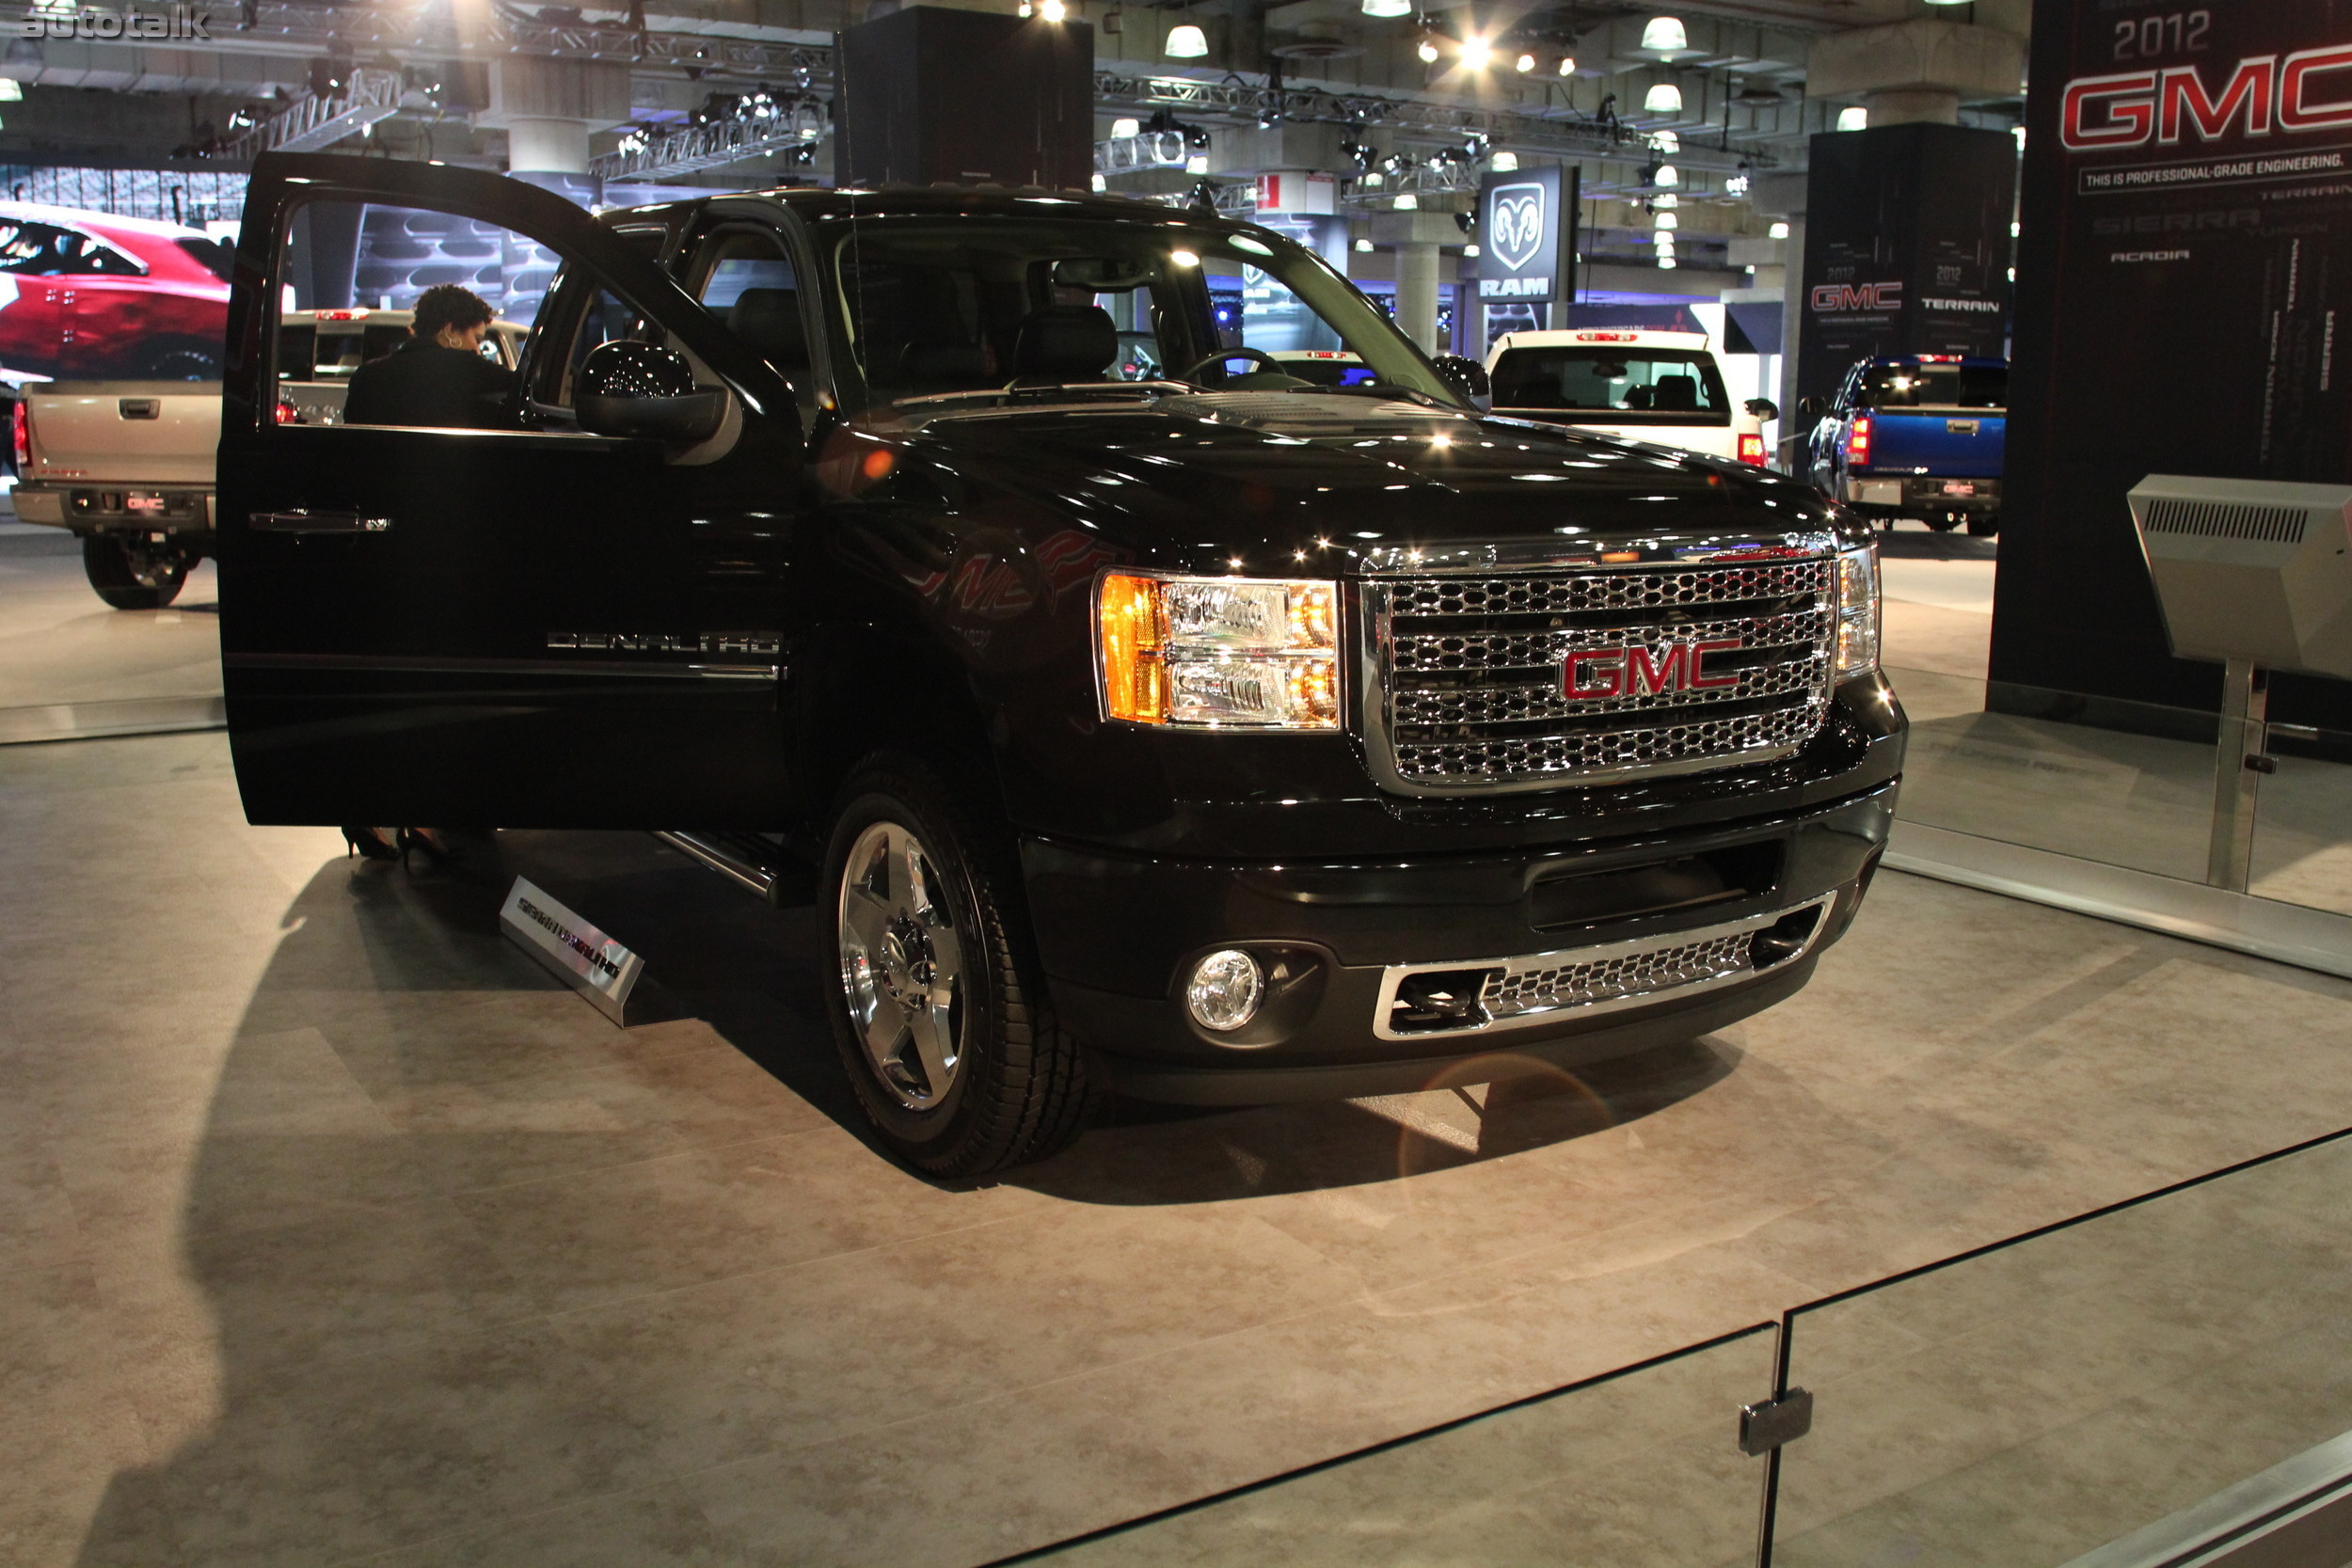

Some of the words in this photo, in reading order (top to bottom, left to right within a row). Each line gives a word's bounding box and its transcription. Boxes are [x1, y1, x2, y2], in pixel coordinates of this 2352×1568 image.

[2114, 9, 2211, 60] 2012
[2060, 43, 2352, 150] GMC
[2087, 174, 2111, 186] THIS
[2113, 173, 2124, 185] IS
[2126, 161, 2254, 183] PROFESSIONAL-GRADE
[2257, 153, 2344, 174] ENGINEERING.
[2111, 249, 2190, 263] ACADIA
[1480, 277, 1549, 296] RAM
[1812, 281, 1903, 311] GMC
[1921, 297, 2000, 312] TERRAIN
[1560, 637, 1741, 701] GMC
